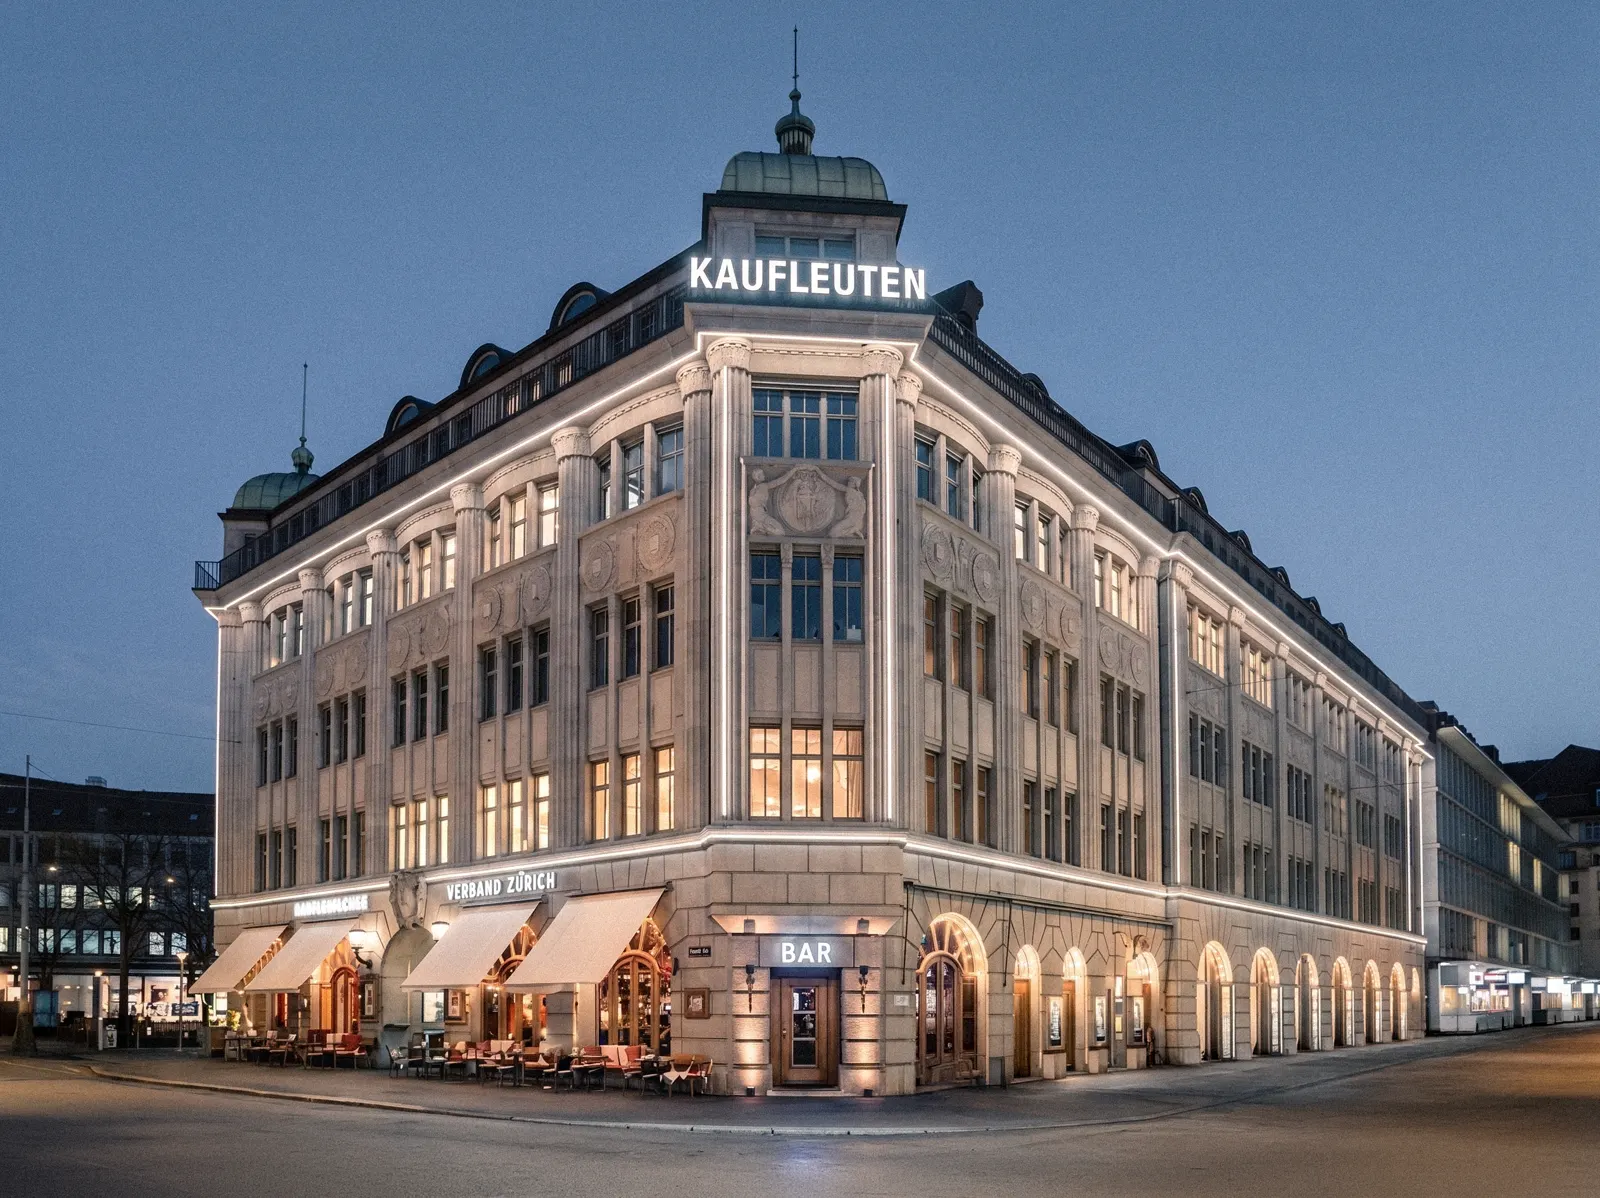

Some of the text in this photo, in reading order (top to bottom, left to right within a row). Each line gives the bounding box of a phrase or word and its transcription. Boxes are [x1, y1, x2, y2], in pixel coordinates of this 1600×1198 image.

[690, 257, 926, 299] KAUFLEUTEN
[446, 871, 555, 900] VERBAND ZÜRICH
[781, 942, 831, 963] BAR
